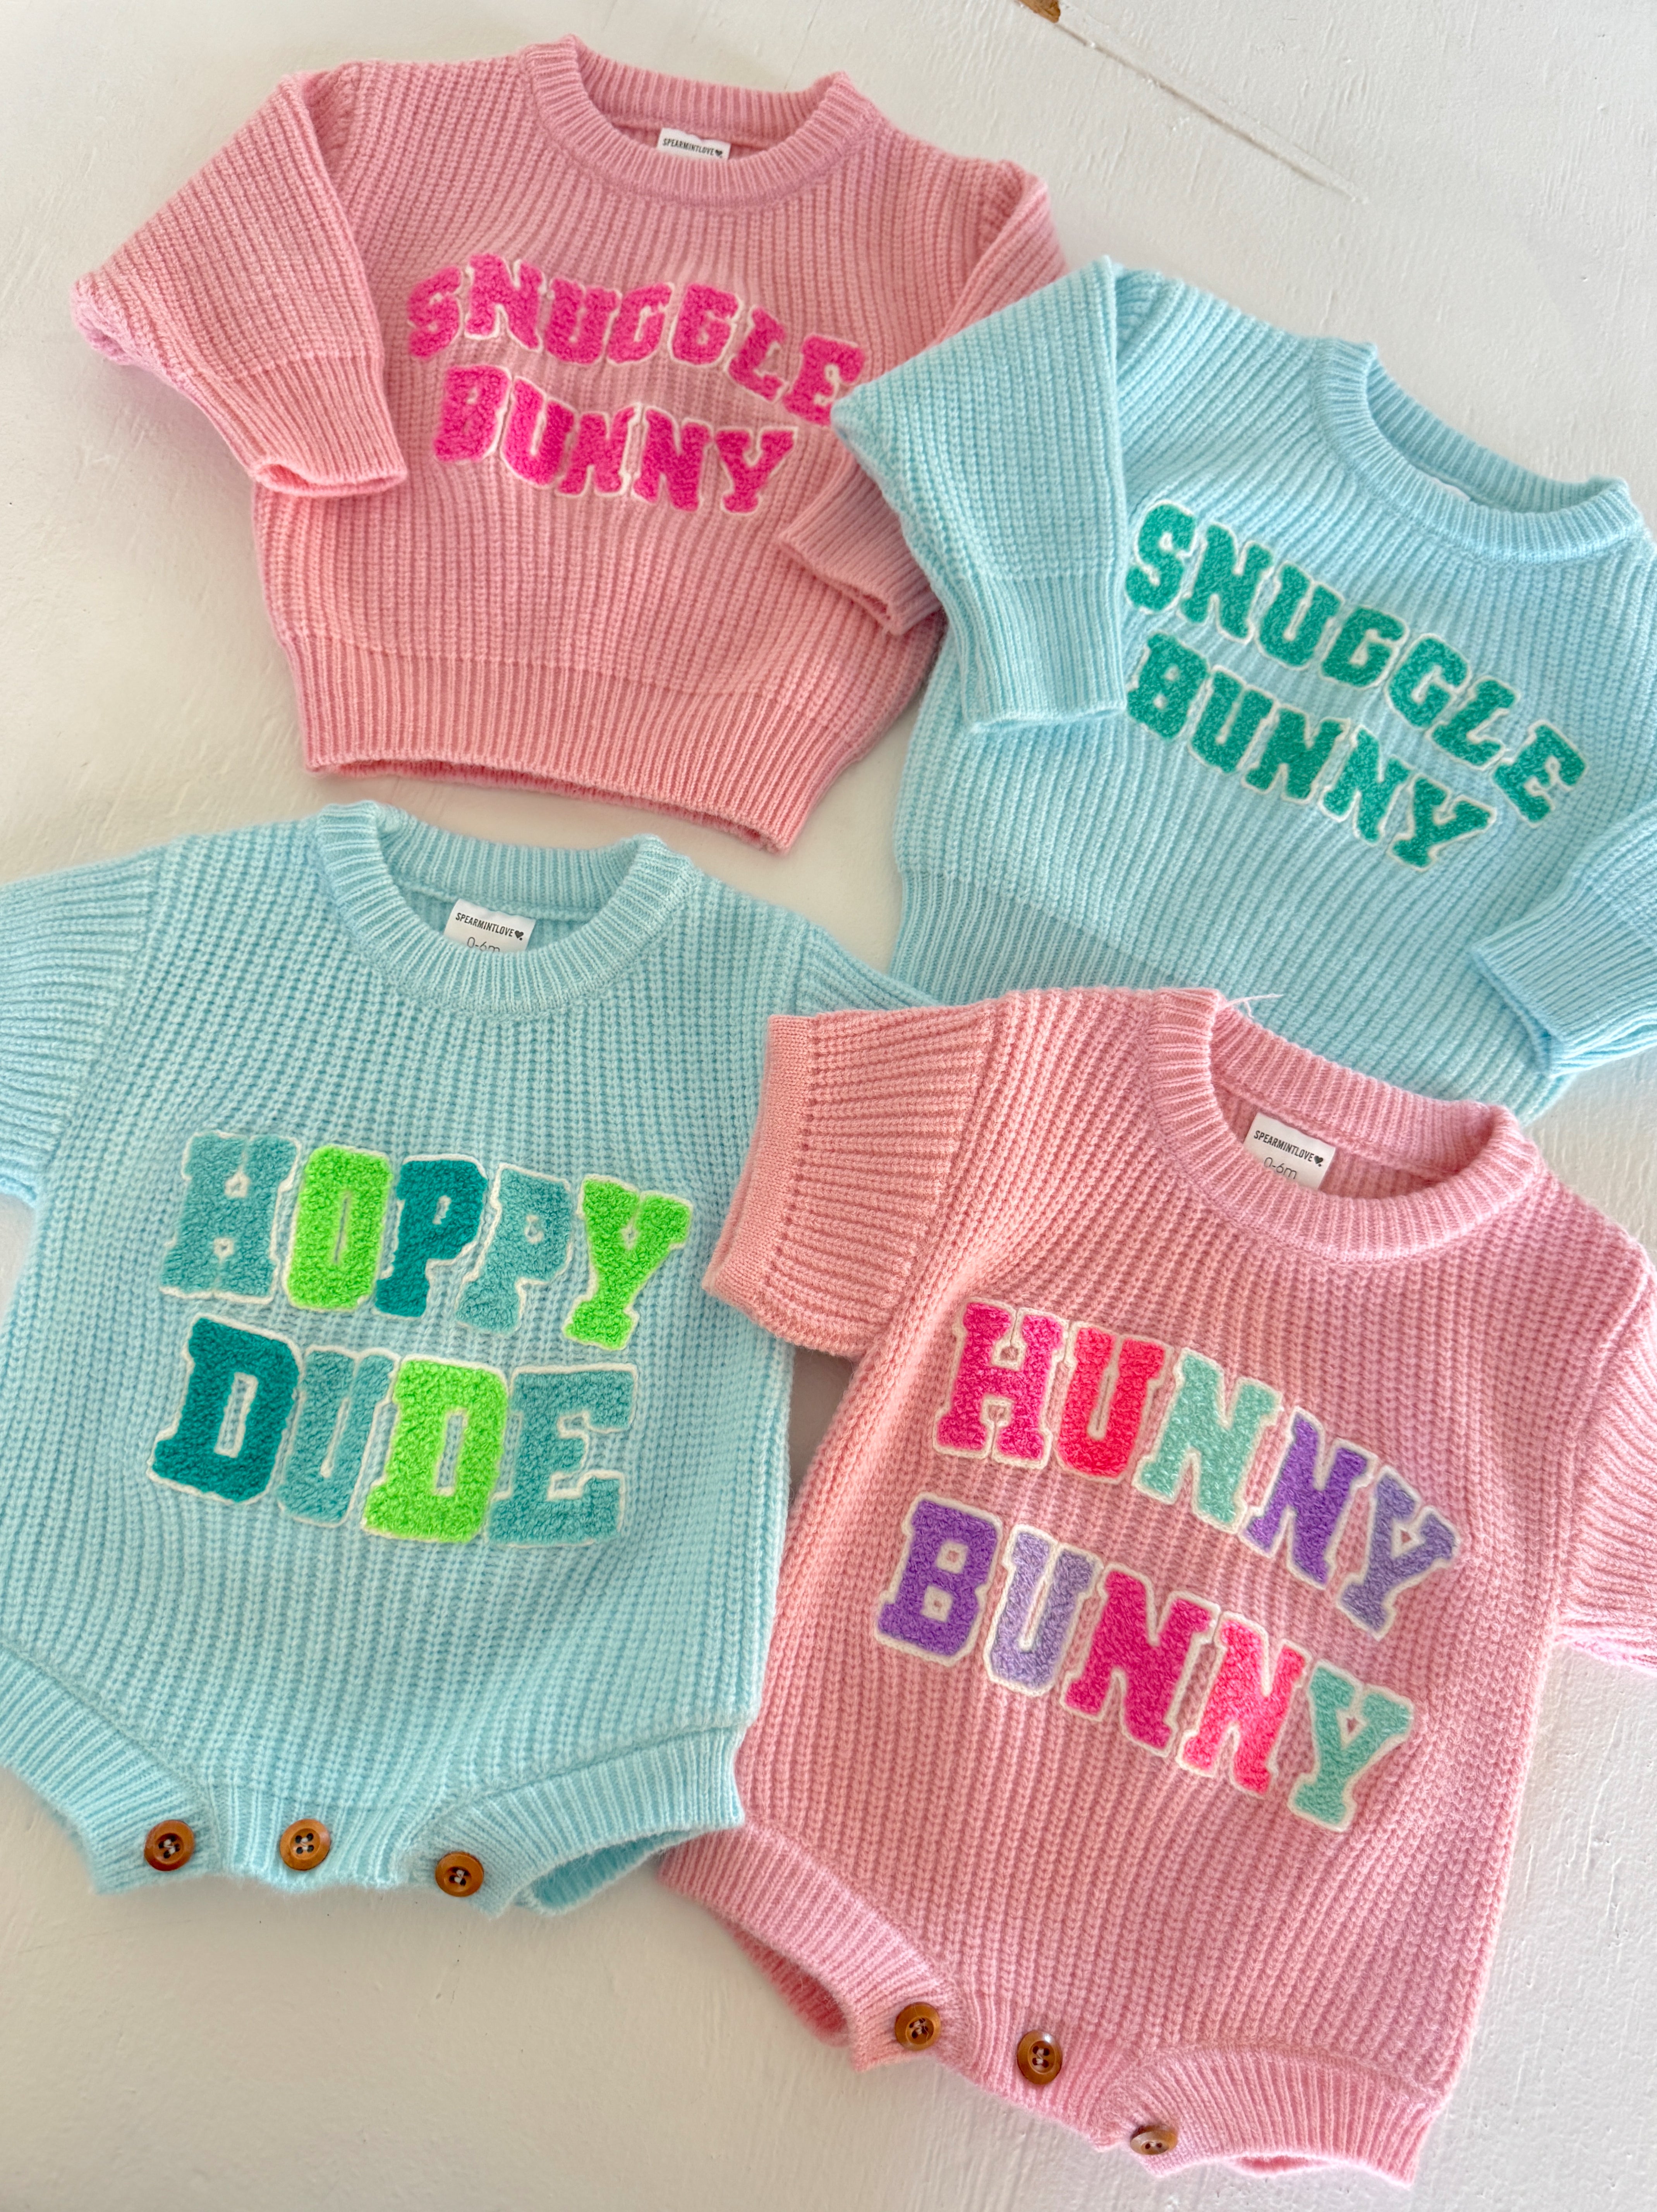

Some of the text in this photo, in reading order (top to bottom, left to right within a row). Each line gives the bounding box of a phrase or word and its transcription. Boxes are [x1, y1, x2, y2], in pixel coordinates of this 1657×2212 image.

[663, 138, 714, 156] SPEARMINTLOVE
[407, 253, 865, 426] SNUGGLE
[433, 364, 798, 514] BUNNY
[1124, 500, 1586, 827] SNUGGLE
[1126, 630, 1496, 871] BUNNY
[455, 912, 514, 937] SPEARMINTLOVE
[159, 1130, 693, 1350] HOPPY
[1254, 1130, 1314, 1162] SPEARMINTLOVE
[1264, 1157, 1297, 1180] 0-6m
[147, 1314, 638, 1548] DUDE
[932, 1296, 1461, 1640] HUNNY
[874, 1491, 1415, 1832] BUNNY
